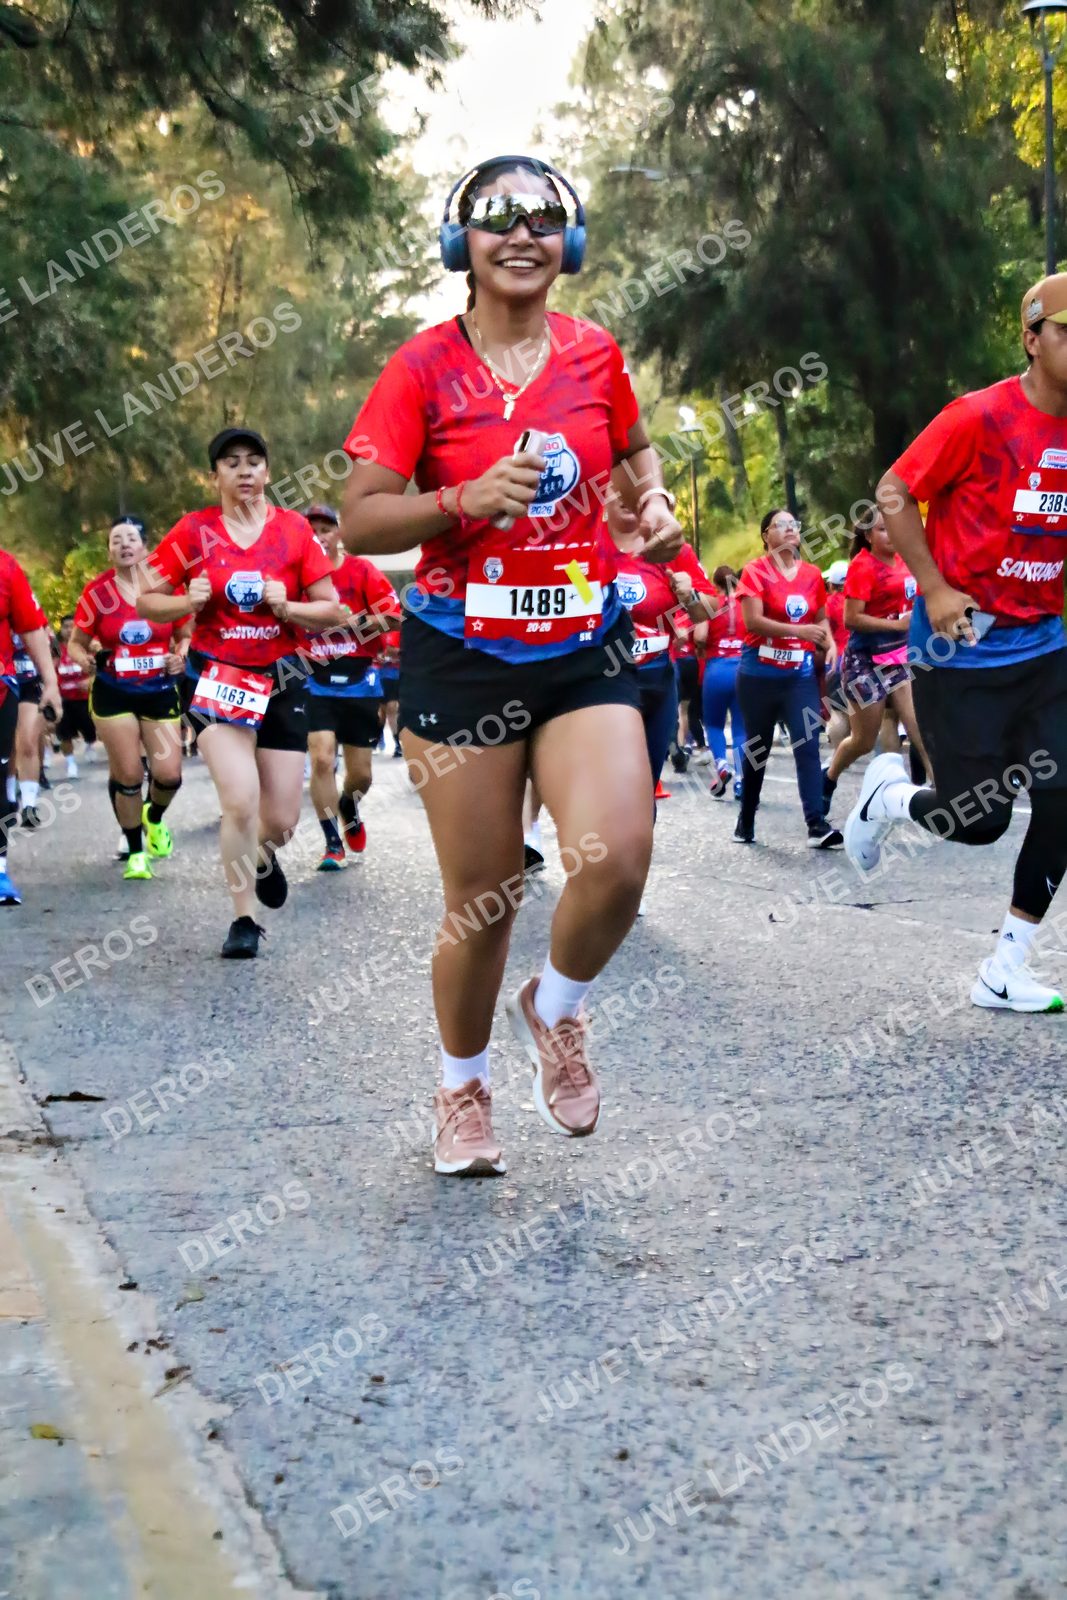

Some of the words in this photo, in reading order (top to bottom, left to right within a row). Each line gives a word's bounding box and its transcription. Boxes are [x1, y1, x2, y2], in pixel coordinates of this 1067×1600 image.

[509, 588, 566, 617] 1489
[133, 657, 154, 669] 1558
[773, 650, 793, 660] 1220
[215, 684, 246, 706] 1463
